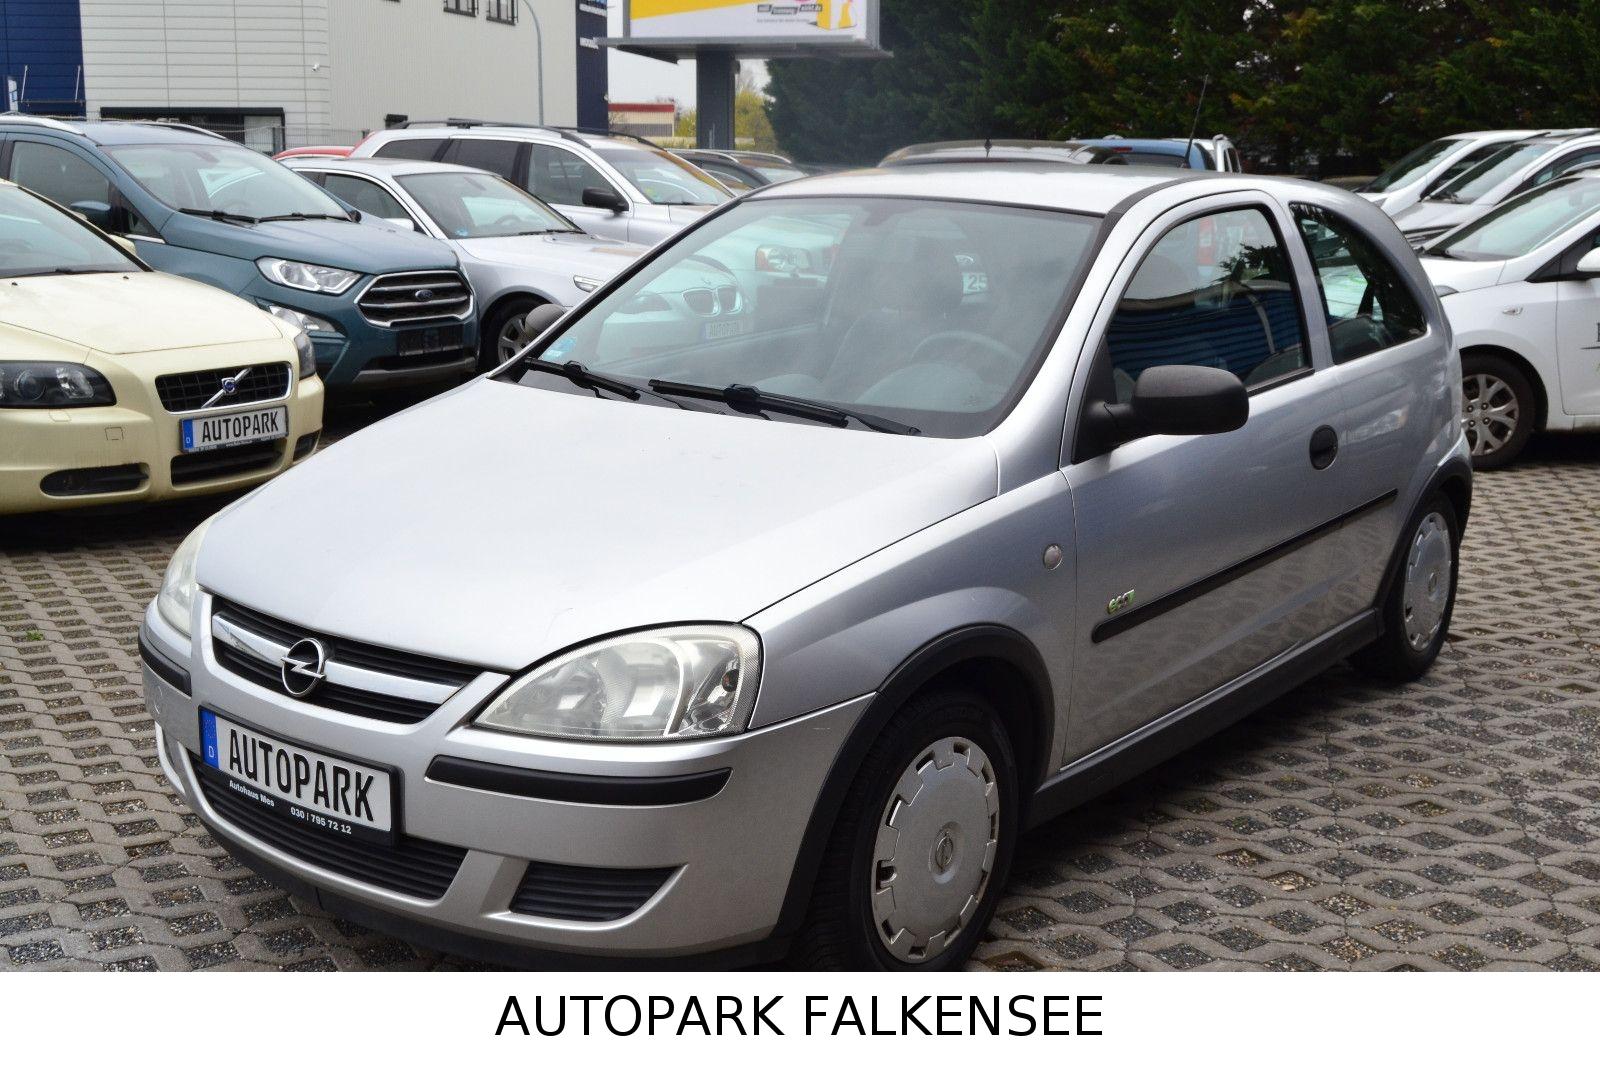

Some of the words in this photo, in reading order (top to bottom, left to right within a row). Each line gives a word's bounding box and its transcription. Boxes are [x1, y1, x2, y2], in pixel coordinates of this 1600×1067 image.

[202, 412, 279, 442] AUTOPARK
[208, 745, 215, 758] D
[229, 728, 374, 822] AUTOPARK
[229, 779, 259, 800] Autohaus
[290, 806, 305, 819] 030
[311, 814, 326, 827] 795
[327, 820, 339, 831] 72
[340, 825, 352, 835] 12
